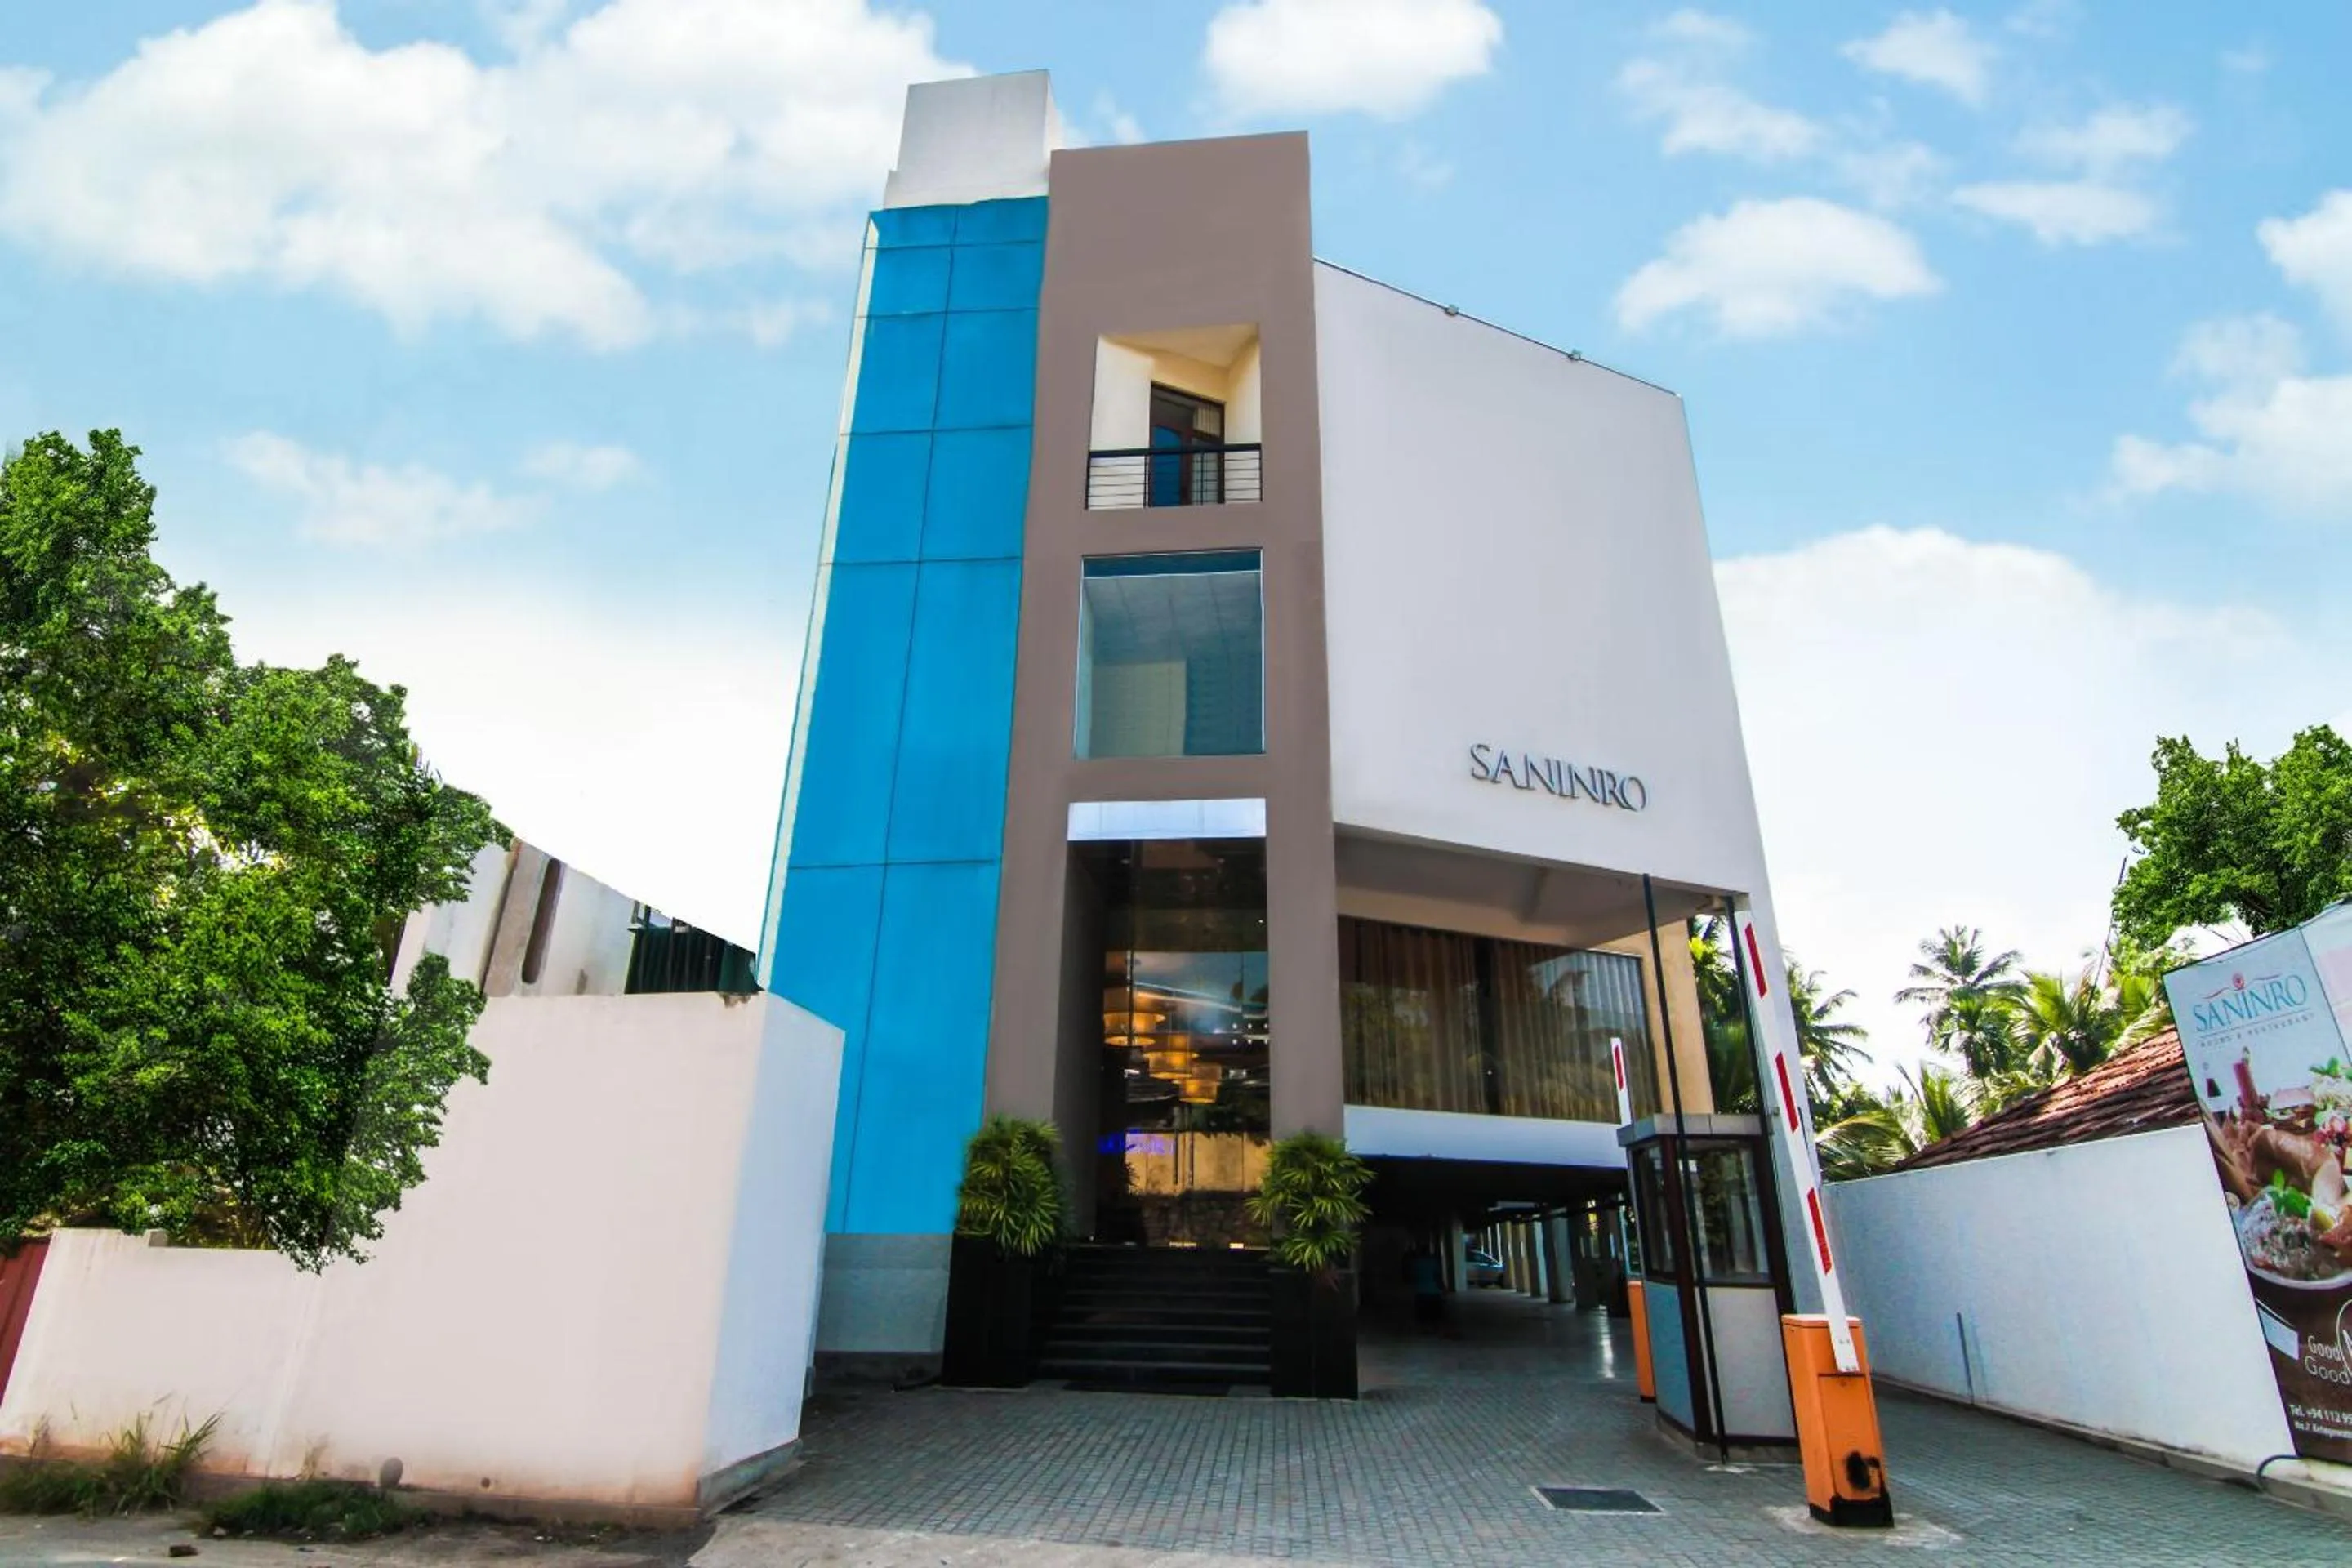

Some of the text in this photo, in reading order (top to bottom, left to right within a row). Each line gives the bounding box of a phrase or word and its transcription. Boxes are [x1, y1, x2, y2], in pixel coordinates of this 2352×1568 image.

[1469, 743, 1646, 812] SANINRO
[2192, 974, 2306, 1032] SANINRO
[2307, 1335, 2342, 1361] Good
[2305, 1356, 2351, 1385] Good
